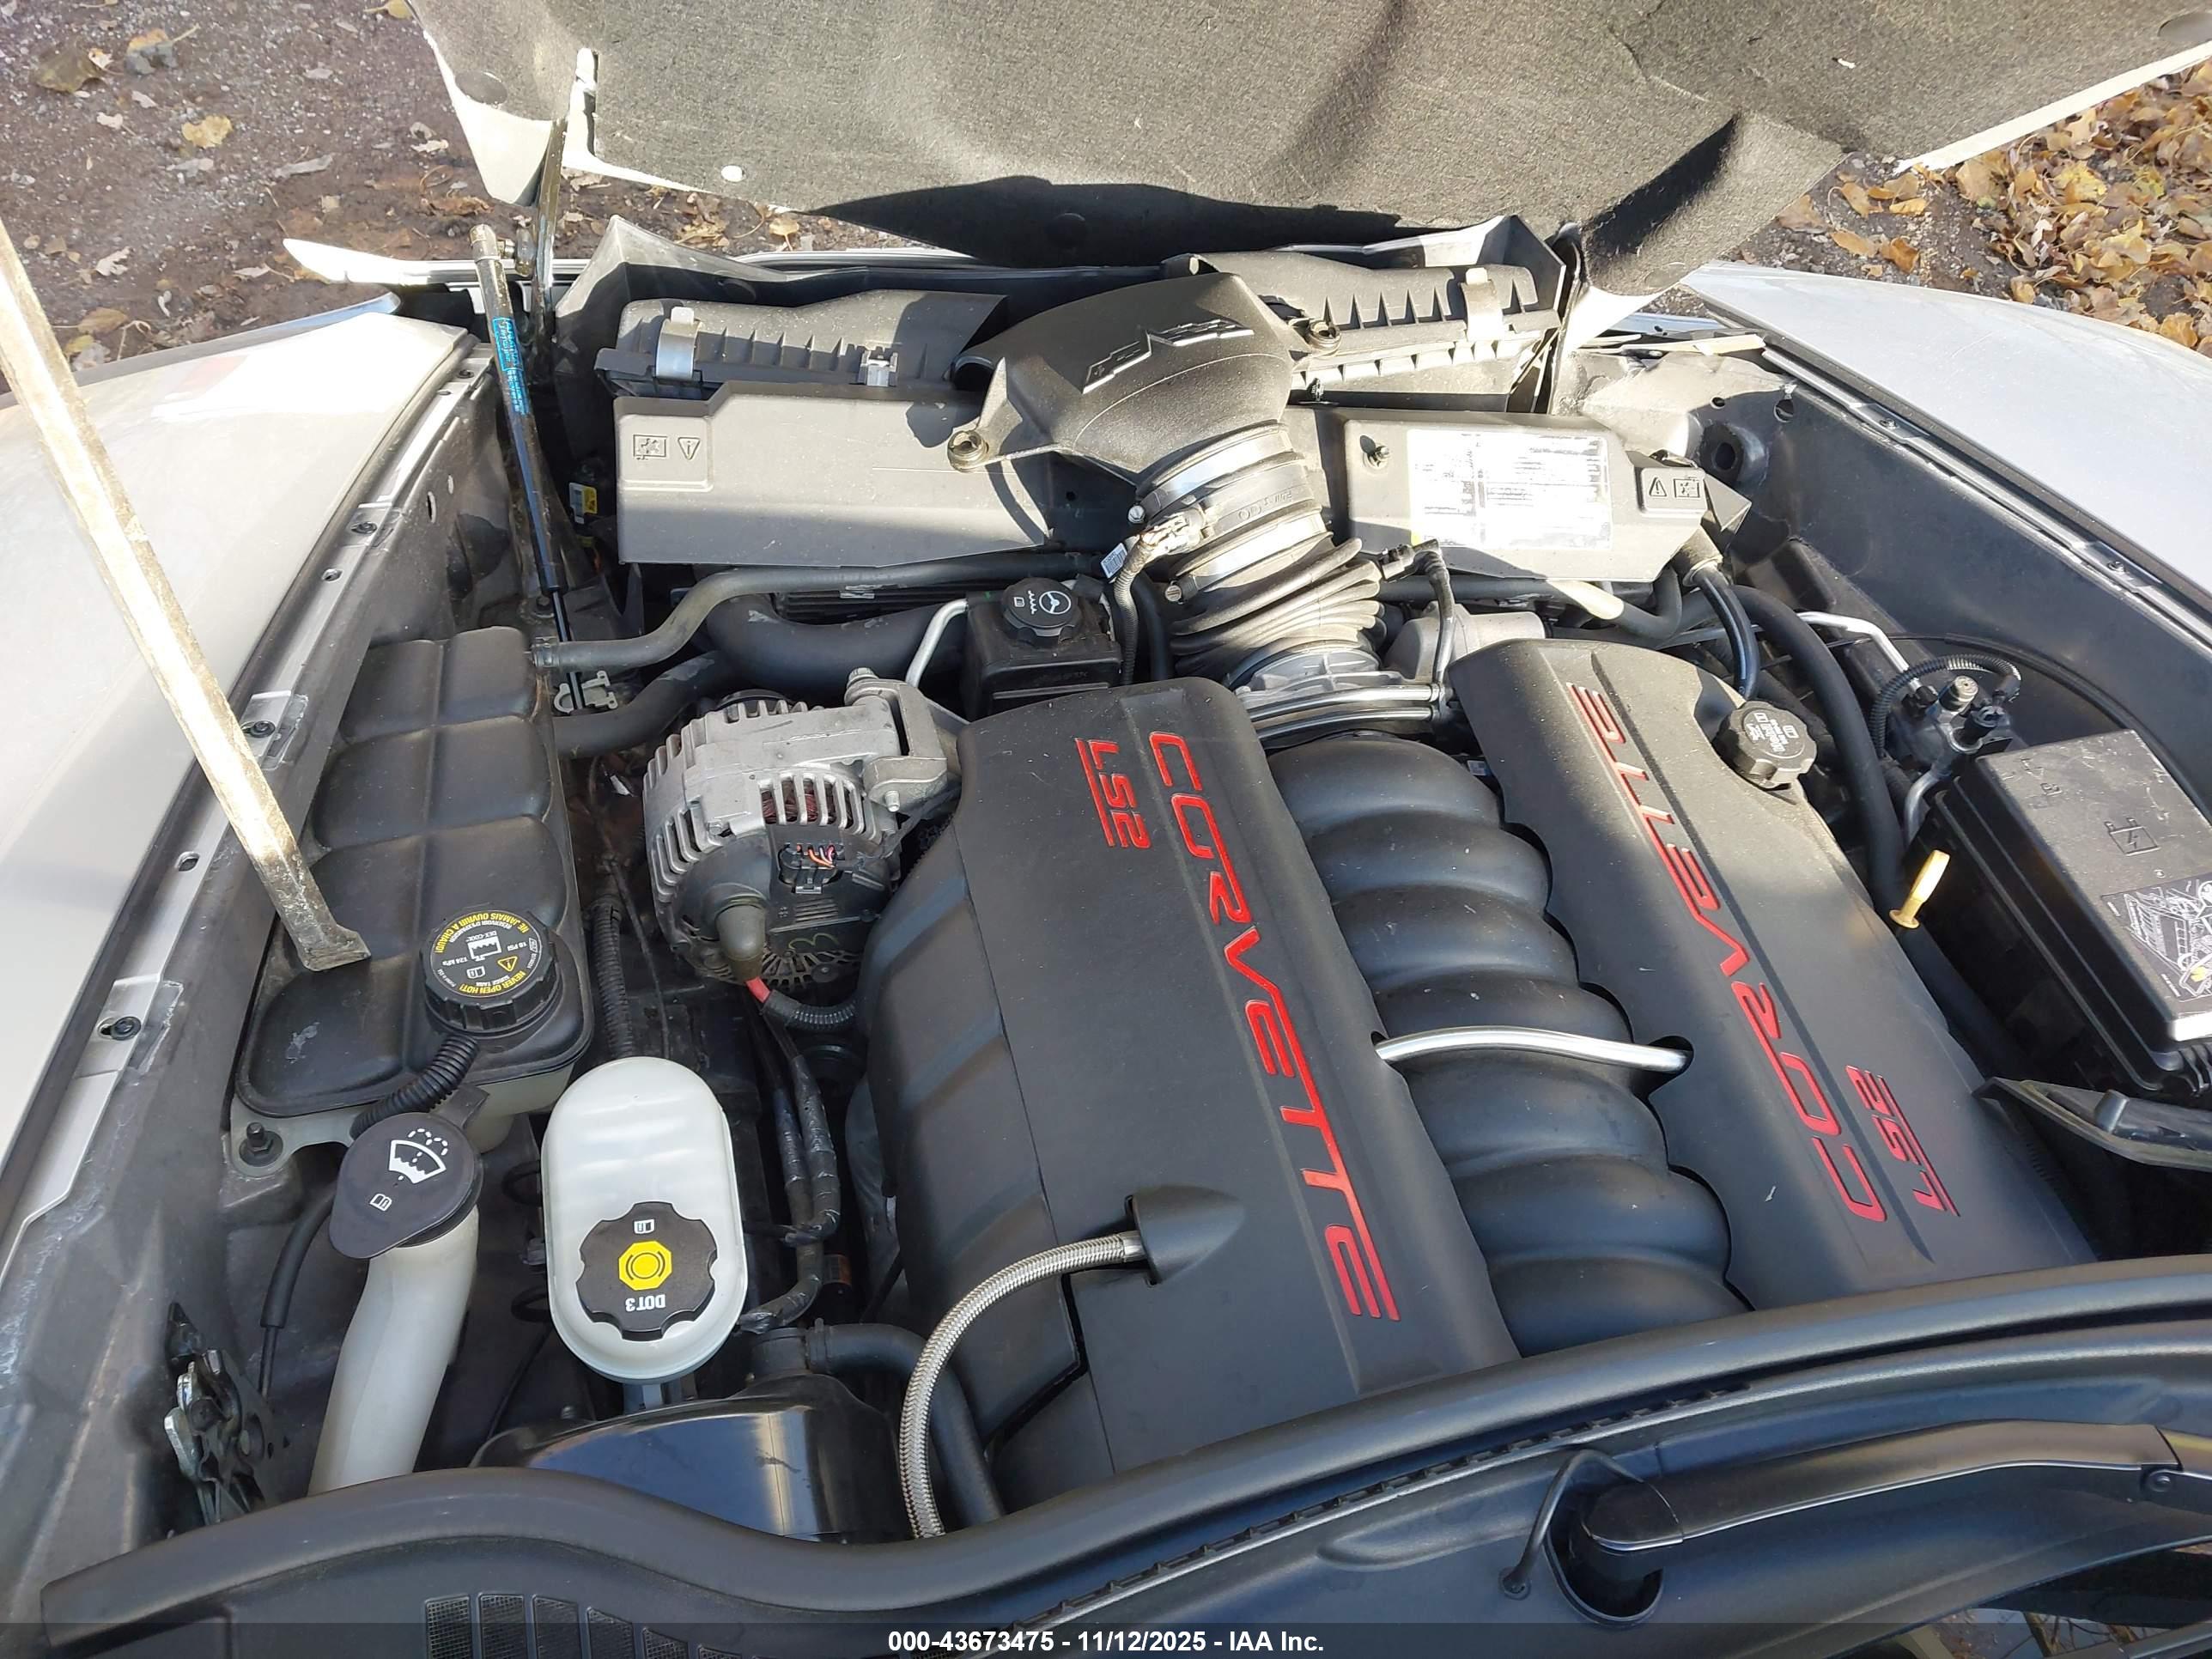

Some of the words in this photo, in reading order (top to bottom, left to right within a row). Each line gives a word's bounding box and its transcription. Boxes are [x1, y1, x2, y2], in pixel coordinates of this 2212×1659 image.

[1084, 738, 1152, 849] LS2
[459, 913, 489, 927] OUVRIR
[490, 913, 521, 926] JAMAIS
[517, 923, 530, 933] NE
[434, 928, 454, 953] CHAUD!
[507, 944, 519, 952] PSI
[455, 957, 468, 965] 124
[1567, 683, 1887, 1224] CORVETTE
[442, 958, 455, 967] kPa
[503, 970, 526, 989] NEVER
[459, 983, 479, 994] HOT!
[479, 983, 501, 994] OPEN
[1148, 732, 1401, 1322] CORVETTE
[1846, 1065, 1948, 1212] LS2
[625, 1297, 635, 1313] 3
[636, 1293, 666, 1311] DOT
